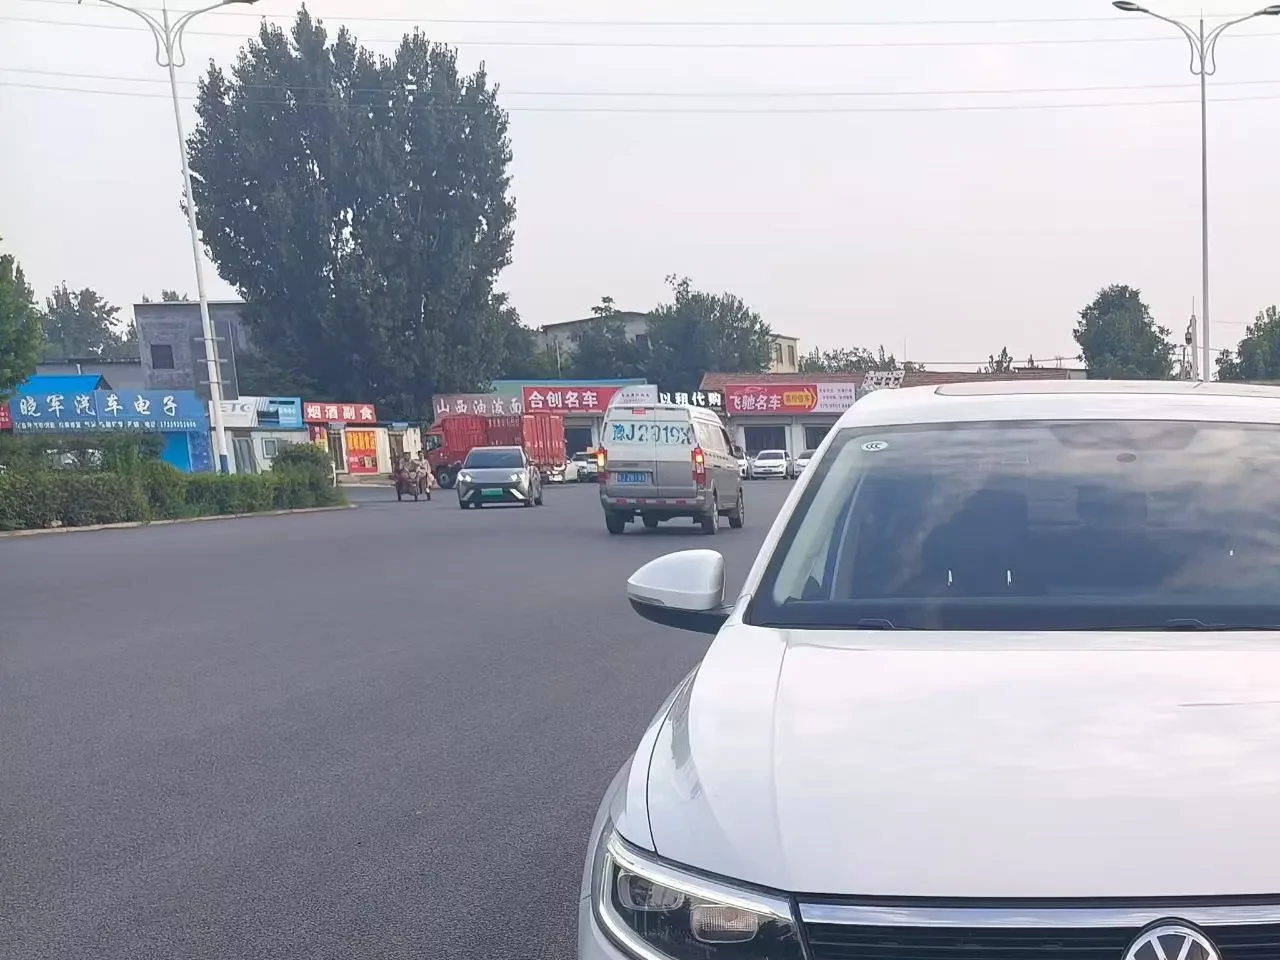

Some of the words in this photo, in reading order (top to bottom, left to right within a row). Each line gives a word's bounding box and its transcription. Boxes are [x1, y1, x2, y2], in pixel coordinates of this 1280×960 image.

[19, 394, 178, 418] 晓军汽车电子
[528, 391, 599, 409] 合创名车
[659, 391, 721, 406] 以租代购
[729, 394, 782, 411] 飞驰名车
[307, 405, 373, 420] 烟酒副食
